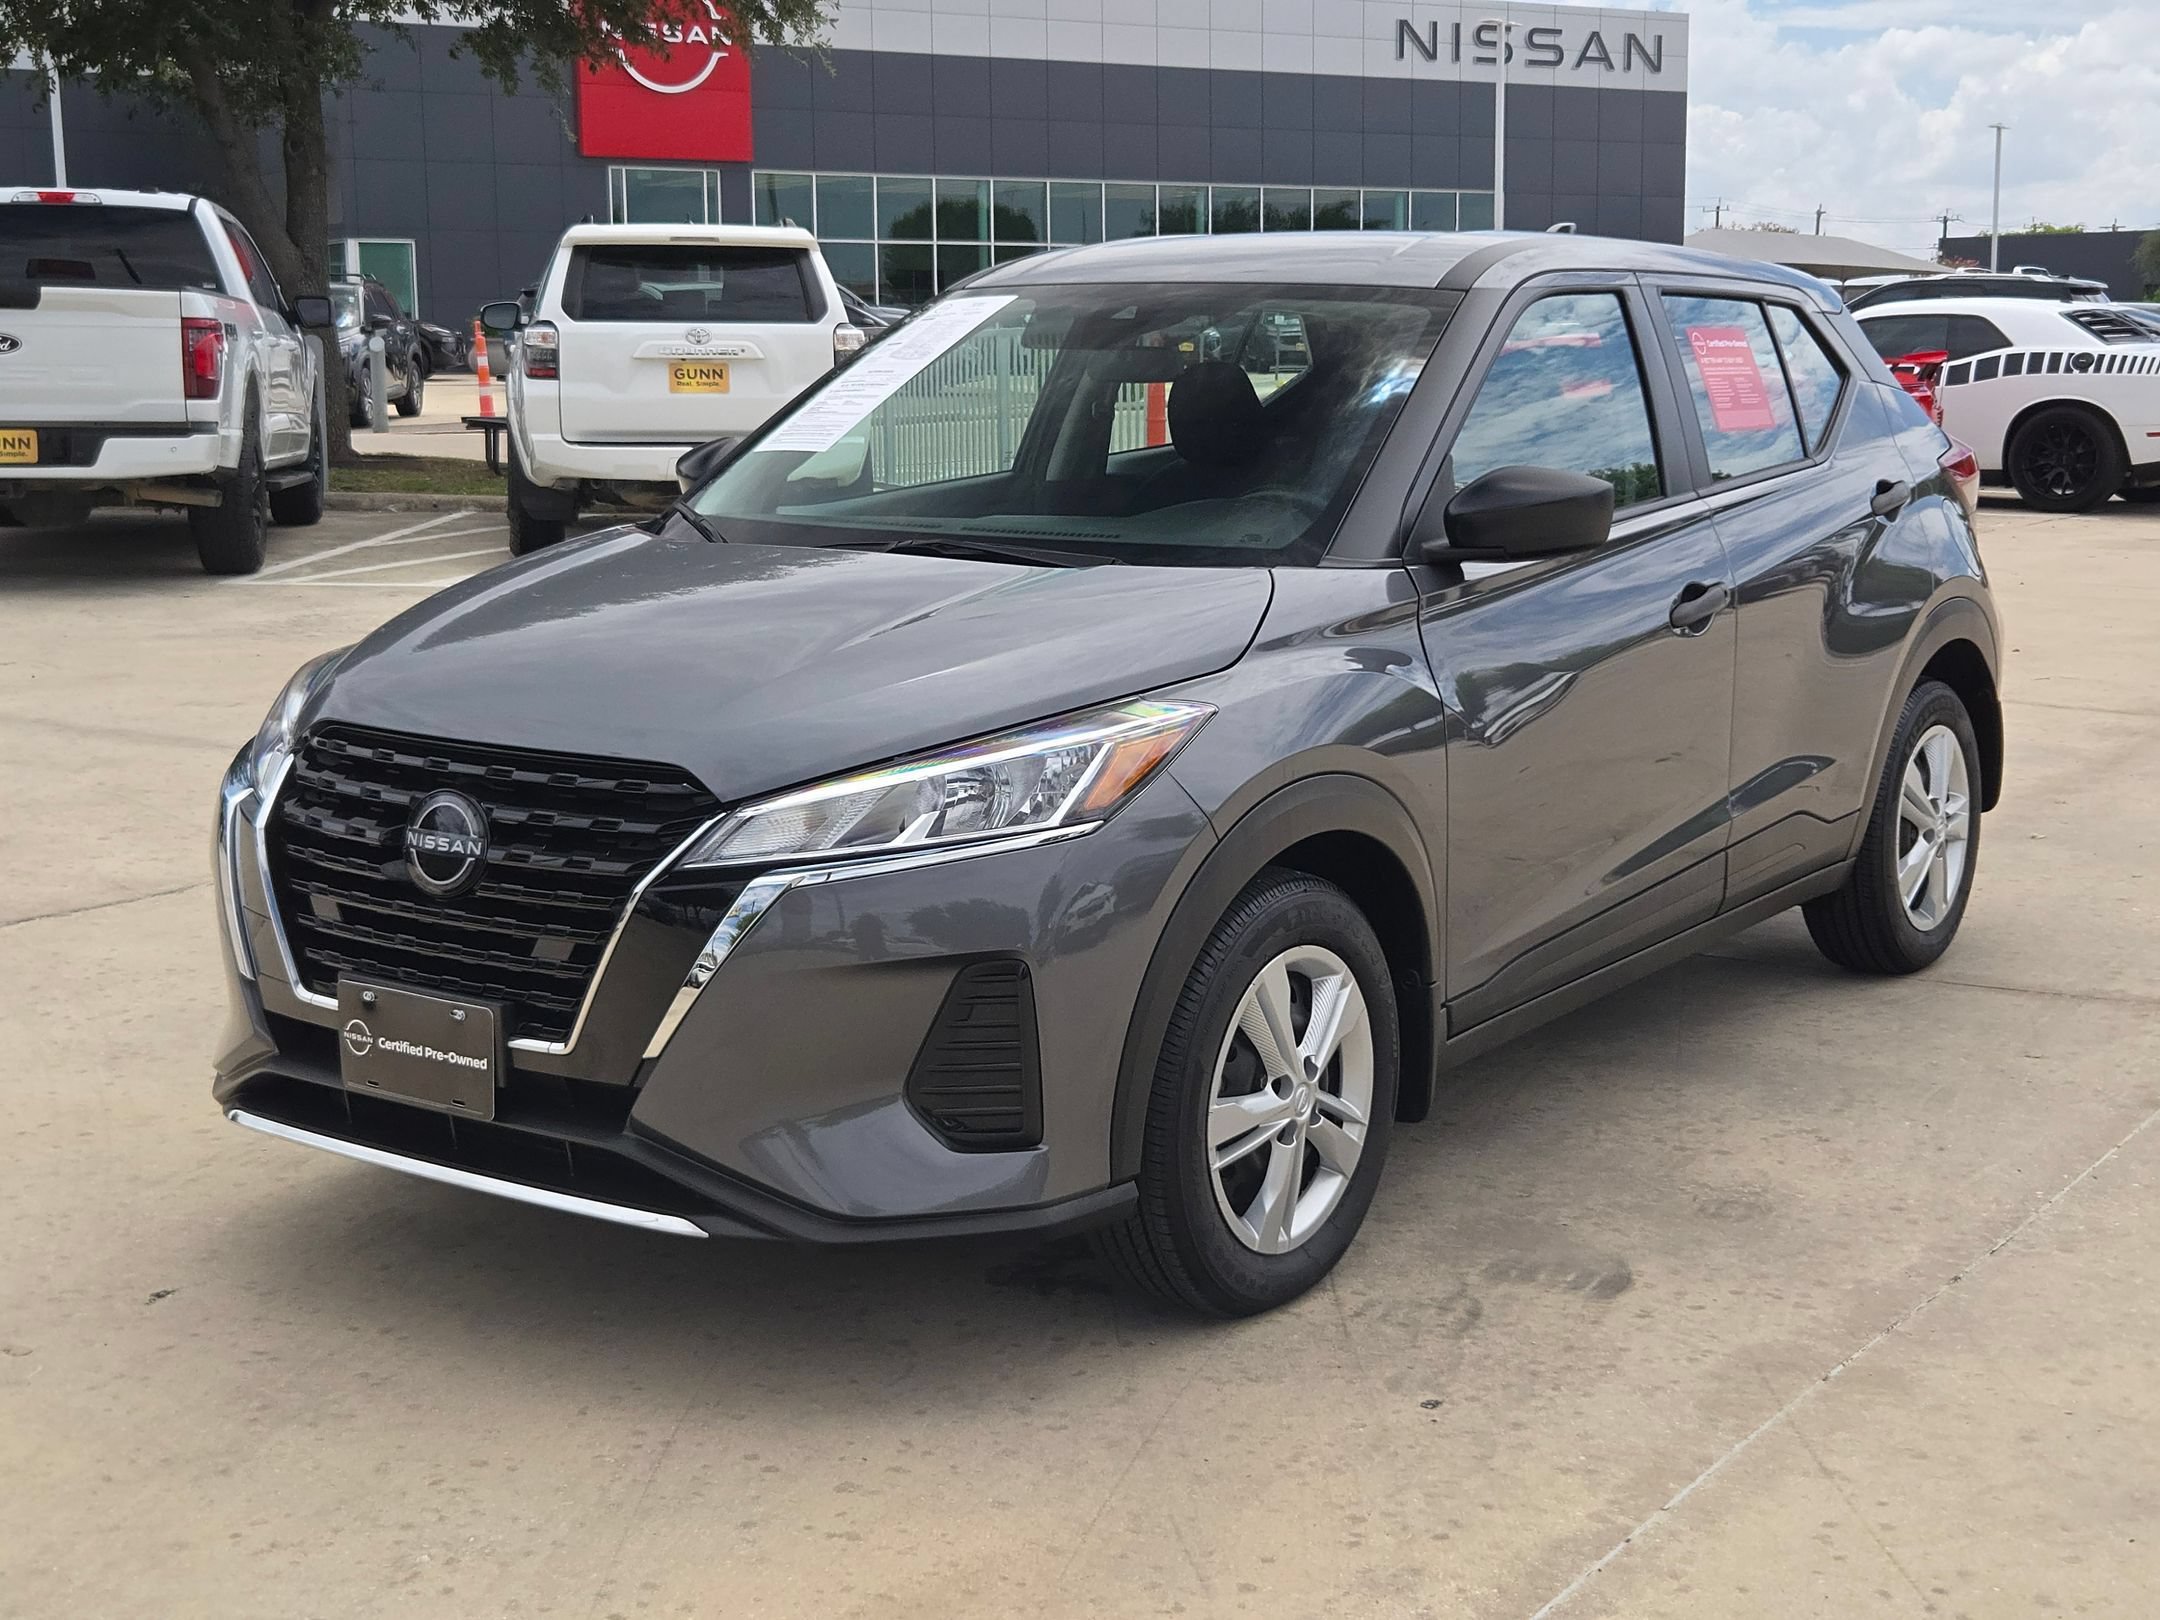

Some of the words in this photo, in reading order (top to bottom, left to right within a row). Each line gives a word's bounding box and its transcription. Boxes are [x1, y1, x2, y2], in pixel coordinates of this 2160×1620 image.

[1397, 19, 1663, 73] NISSAN
[674, 368, 724, 380] GUNN
[0, 437, 31, 450] NN
[407, 831, 482, 855] NISSAN
[344, 1031, 373, 1044] NISSAN
[378, 1037, 423, 1057] Certified
[425, 1047, 488, 1070] Pre-Owned
